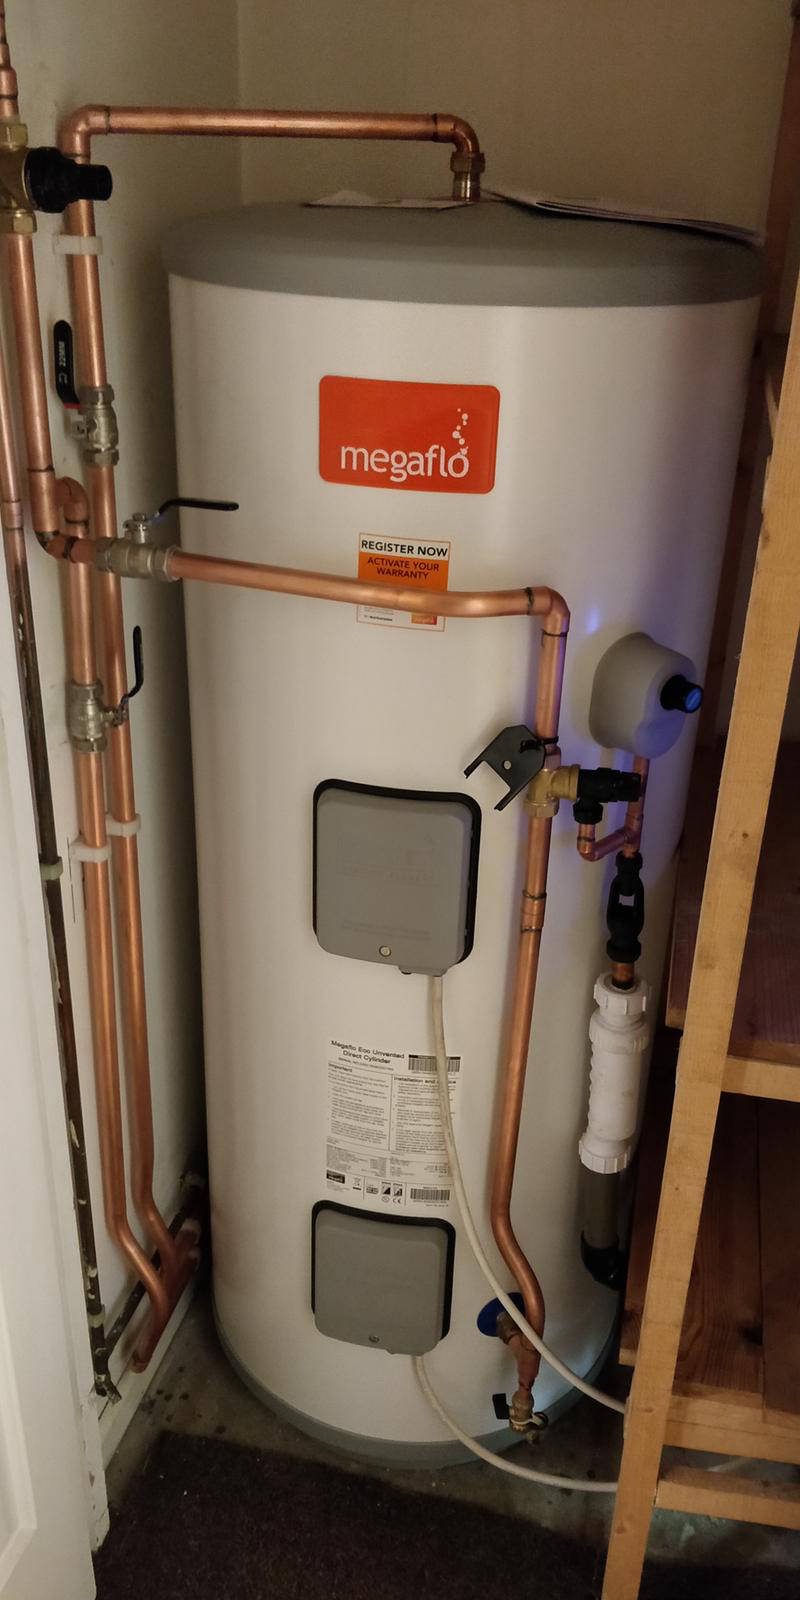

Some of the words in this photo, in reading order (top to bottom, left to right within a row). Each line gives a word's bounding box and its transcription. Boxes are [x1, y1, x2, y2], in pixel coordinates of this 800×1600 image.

[340, 444, 470, 483] megaflo
[361, 539, 414, 555] REGISTER
[417, 545, 448, 557] NOW
[367, 556, 410, 569] ACTIVATE
[413, 560, 440, 572] YOUR
[376, 567, 429, 580] WARRANTY
[343, 1050, 362, 1059] Direct
[364, 1054, 391, 1064] Cylinder
[373, 1049, 405, 1059] Unvented
